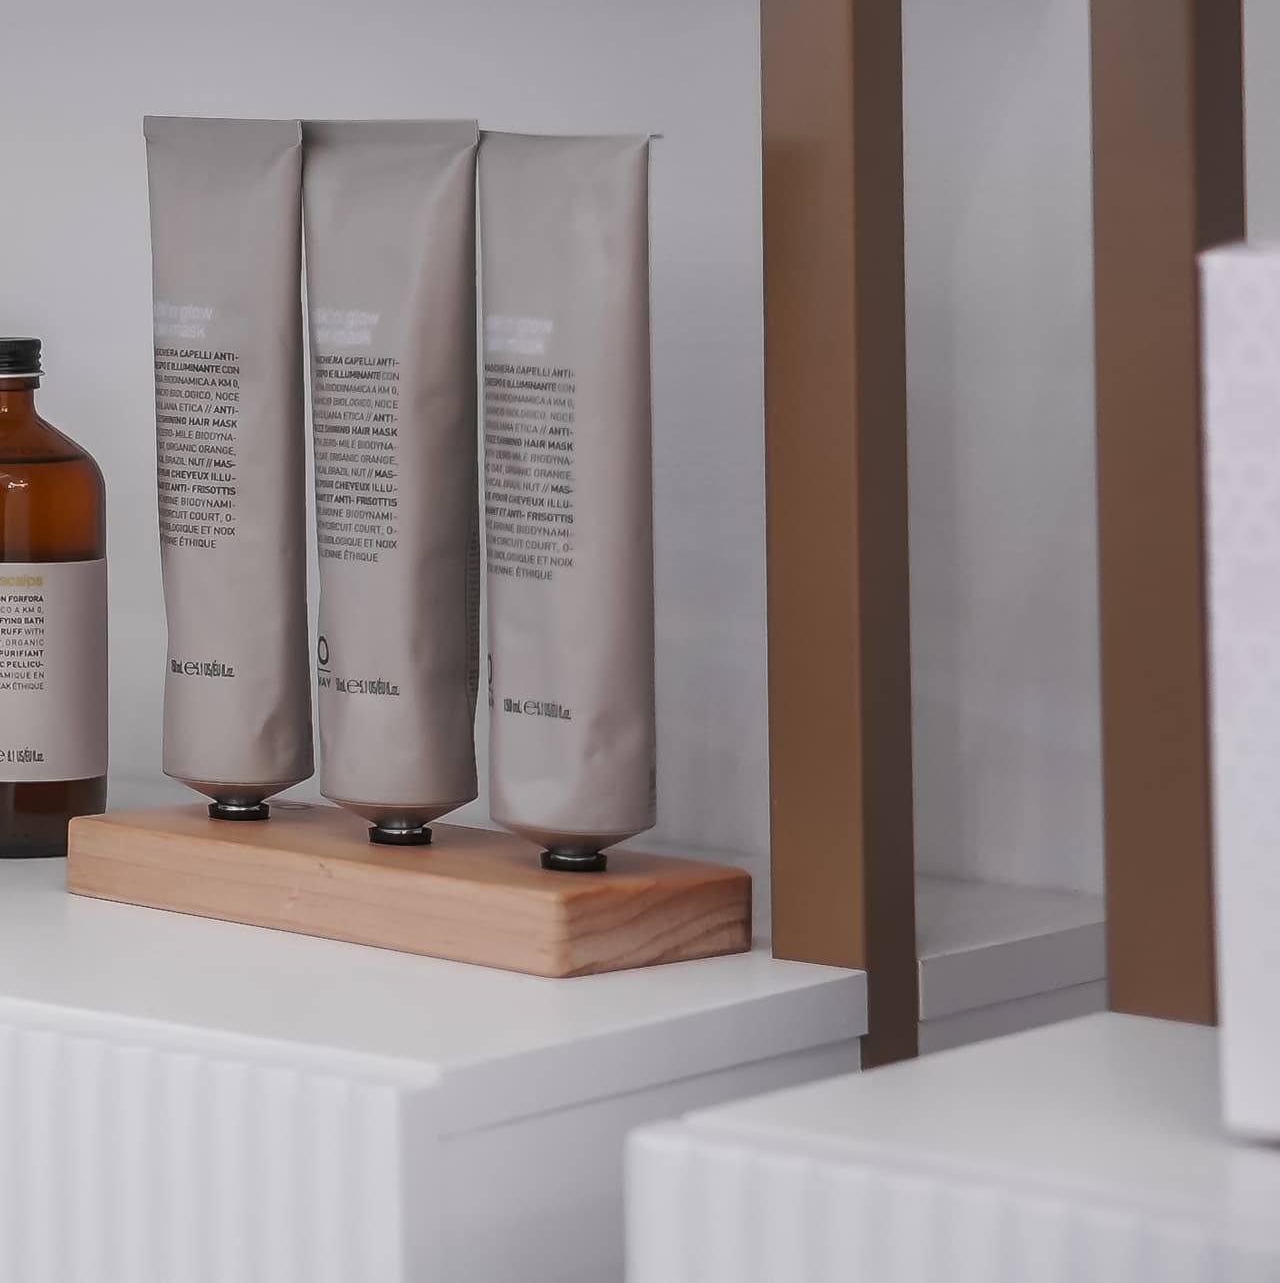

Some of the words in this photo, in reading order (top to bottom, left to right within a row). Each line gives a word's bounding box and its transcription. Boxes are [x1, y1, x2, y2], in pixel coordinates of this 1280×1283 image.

[180, 350, 212, 360] CAPELLI
[213, 351, 239, 361] ANTI-
[344, 356, 376, 367] CAPELLI
[376, 356, 400, 368] ANTI-
[221, 365, 240, 376] CON
[215, 392, 240, 402] NOCE
[213, 406, 239, 415] ANTI-
[189, 417, 210, 427] HAIR
[212, 418, 238, 429] MASK
[372, 412, 399, 423] ANTI-
[351, 424, 370, 435] HAIR
[372, 425, 398, 437] MASK
[547, 425, 574, 438] ANTI-
[524, 437, 546, 450] HAIR
[547, 439, 574, 452] MASK
[189, 456, 206, 466] NUT
[213, 457, 236, 468] MAS-
[171, 469, 209, 481] CHEVEUX
[210, 472, 236, 482] ILLU-
[374, 468, 398, 480] MAS-
[192, 483, 237, 496] FRISOTTIS
[334, 481, 370, 492] CHEVEUX
[371, 482, 398, 494] ILLU-
[550, 482, 574, 495] MAS-
[355, 495, 398, 507] FRISOTTIS
[526, 509, 574, 525] FRISOTTIS
[200, 525, 211, 535] ET
[213, 525, 236, 537] NOIX
[179, 533, 216, 548] ÉTHIQUE
[375, 538, 397, 549] NOIX
[343, 548, 378, 563] ÉTHIQUE
[550, 555, 574, 568] NOIX
[0, 574, 44, 588] scalps
[8, 595, 44, 603] FORFORA
[22, 606, 35, 614] KM
[24, 617, 45, 625] BATH
[24, 628, 45, 636] WITH
[5, 639, 45, 648] ORGANIC
[6, 660, 44, 669] PELLICU-
[32, 671, 45, 680] EN
[11, 680, 45, 692] ÉTHIQUE
